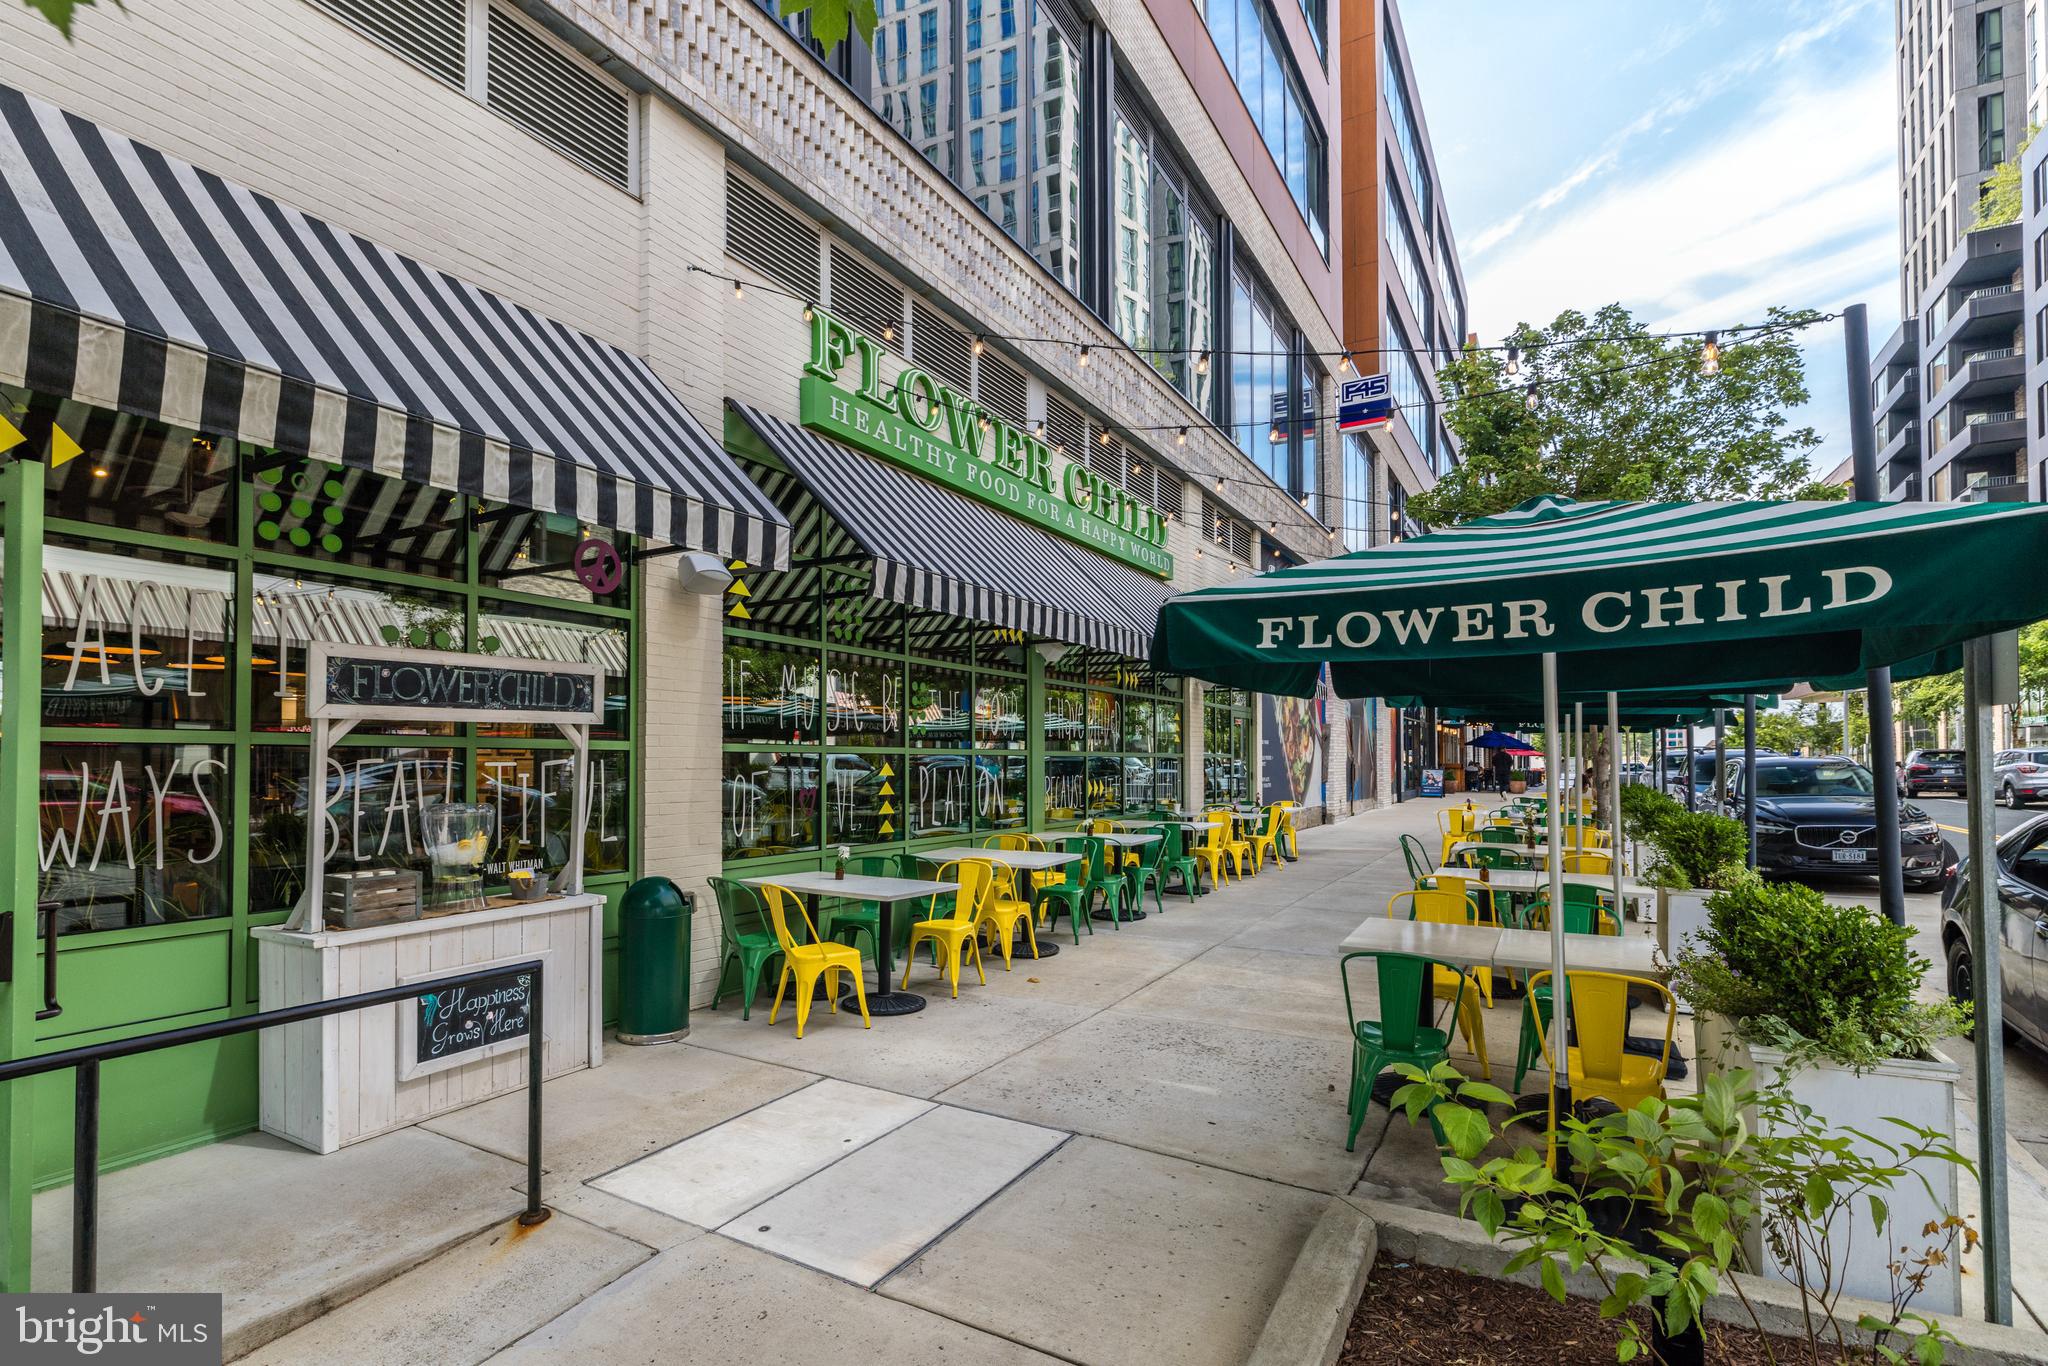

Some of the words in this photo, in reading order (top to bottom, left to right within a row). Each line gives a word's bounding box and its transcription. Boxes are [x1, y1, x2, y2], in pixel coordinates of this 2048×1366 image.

[1342, 375, 1389, 403] F45
[804, 306, 1057, 493] FLOWER
[1063, 462, 1169, 548] CHILD
[830, 395, 957, 474] HEALTHY
[966, 461, 1020, 502] FOOD
[1026, 493, 1060, 522] FOR
[1065, 511, 1076, 529] A
[1081, 518, 1126, 552] HAPPY
[1130, 541, 1171, 572] WORLD
[1255, 598, 1555, 650] FLOWER
[1581, 565, 1893, 633] CHILD
[352, 664, 492, 704] FLOWER
[499, 671, 576, 708] CHILD
[730, 658, 751, 731] IF
[780, 664, 864, 732] MUSIC
[882, 673, 902, 733] BE
[733, 770, 768, 840] OF
[919, 765, 967, 828] PLAY
[978, 767, 1004, 817] ON
[1045, 774, 1084, 811] BECAUSE
[508, 858, 544, 873] WHITMAN
[438, 986, 526, 1020] Happiness
[432, 1022, 481, 1054] Grows
[490, 1008, 524, 1036] Here
